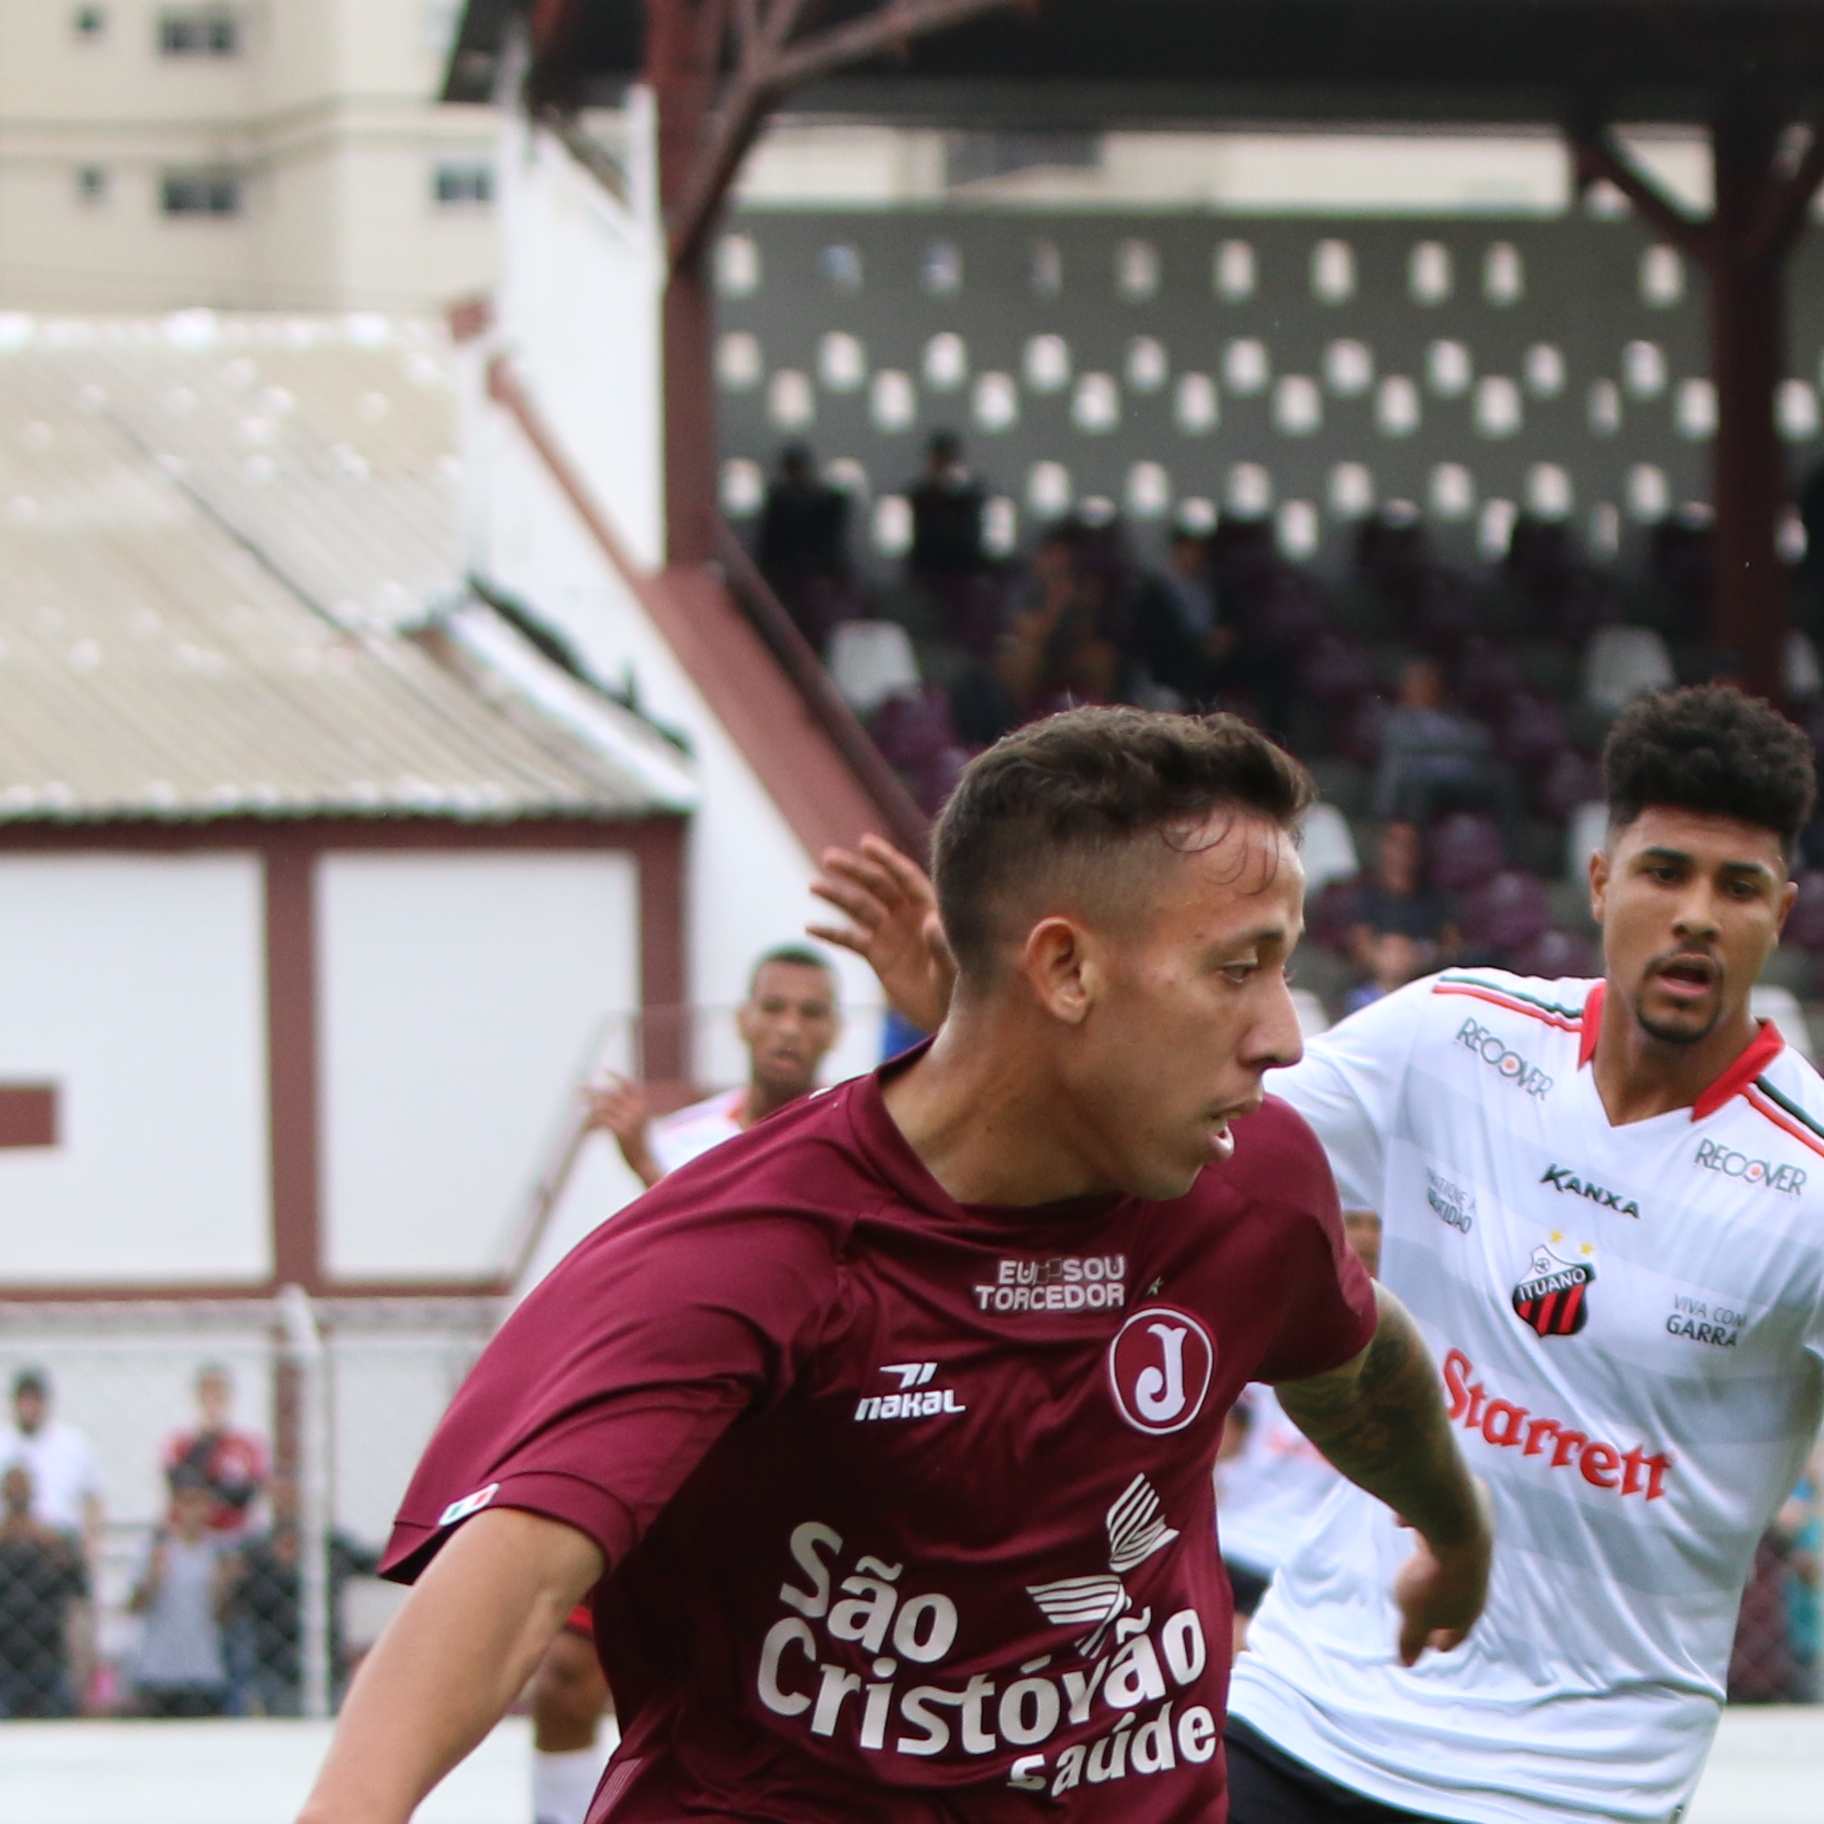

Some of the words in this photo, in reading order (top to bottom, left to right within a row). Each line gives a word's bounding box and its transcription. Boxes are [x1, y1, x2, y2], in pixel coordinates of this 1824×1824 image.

[1456, 1017, 1553, 1101] RECOVER
[1540, 1163, 1640, 1219] KANXA
[1695, 1138, 1807, 1195] RECOVER
[975, 1282, 1125, 1310] TORCEDOR
[998, 1260, 1035, 1285] EU
[1062, 1255, 1125, 1282] SOU
[1519, 1268, 1587, 1301] ITUANO
[1666, 1314, 1737, 1347] GARRA
[1675, 1294, 1707, 1318] VIVA
[1135, 1324, 1187, 1422] J
[1443, 1347, 1673, 1501] Starrett
[779, 1521, 958, 1663] São
[757, 1605, 1206, 1756] Cristóvão
